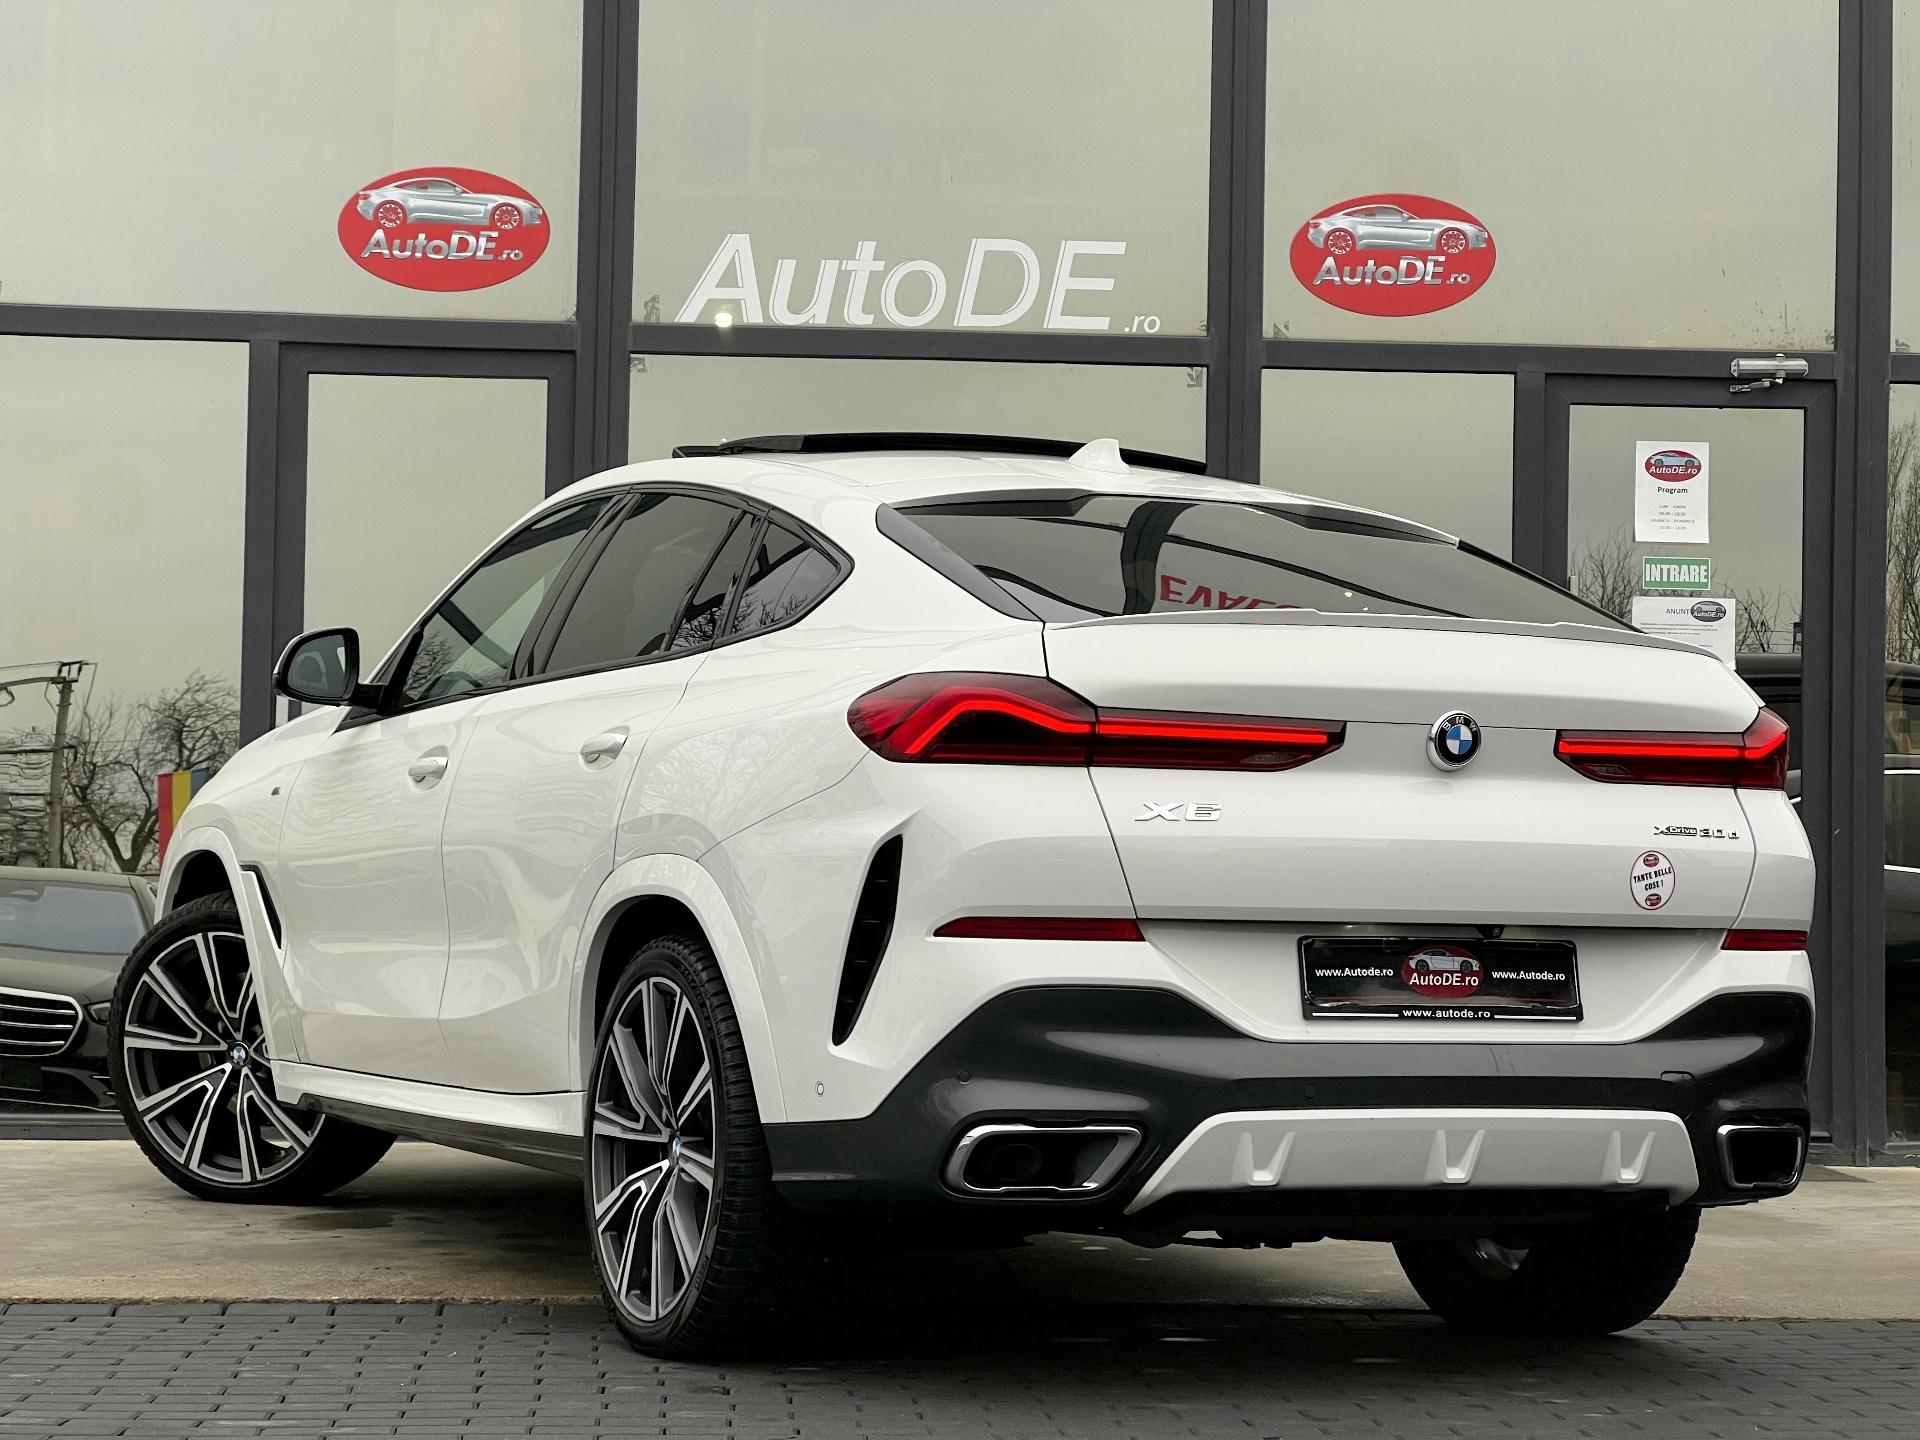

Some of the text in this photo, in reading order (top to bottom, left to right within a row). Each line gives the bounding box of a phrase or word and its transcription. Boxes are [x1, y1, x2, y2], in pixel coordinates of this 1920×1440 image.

[1648, 466, 1698, 475] AutoDE.ro
[1657, 486, 1688, 494] Program
[1645, 564, 1708, 582] INTRARE
[1134, 801, 1222, 822] X6
[1633, 866, 1672, 883] TANTE BELLE
[1644, 880, 1660, 891] COSE
[1315, 967, 1394, 977] www.Autode.ro
[1491, 970, 1566, 981] www.Autode.ro
[1409, 972, 1479, 987] AutoDE.ro
[1402, 1008, 1491, 1019] www.autode.ro
